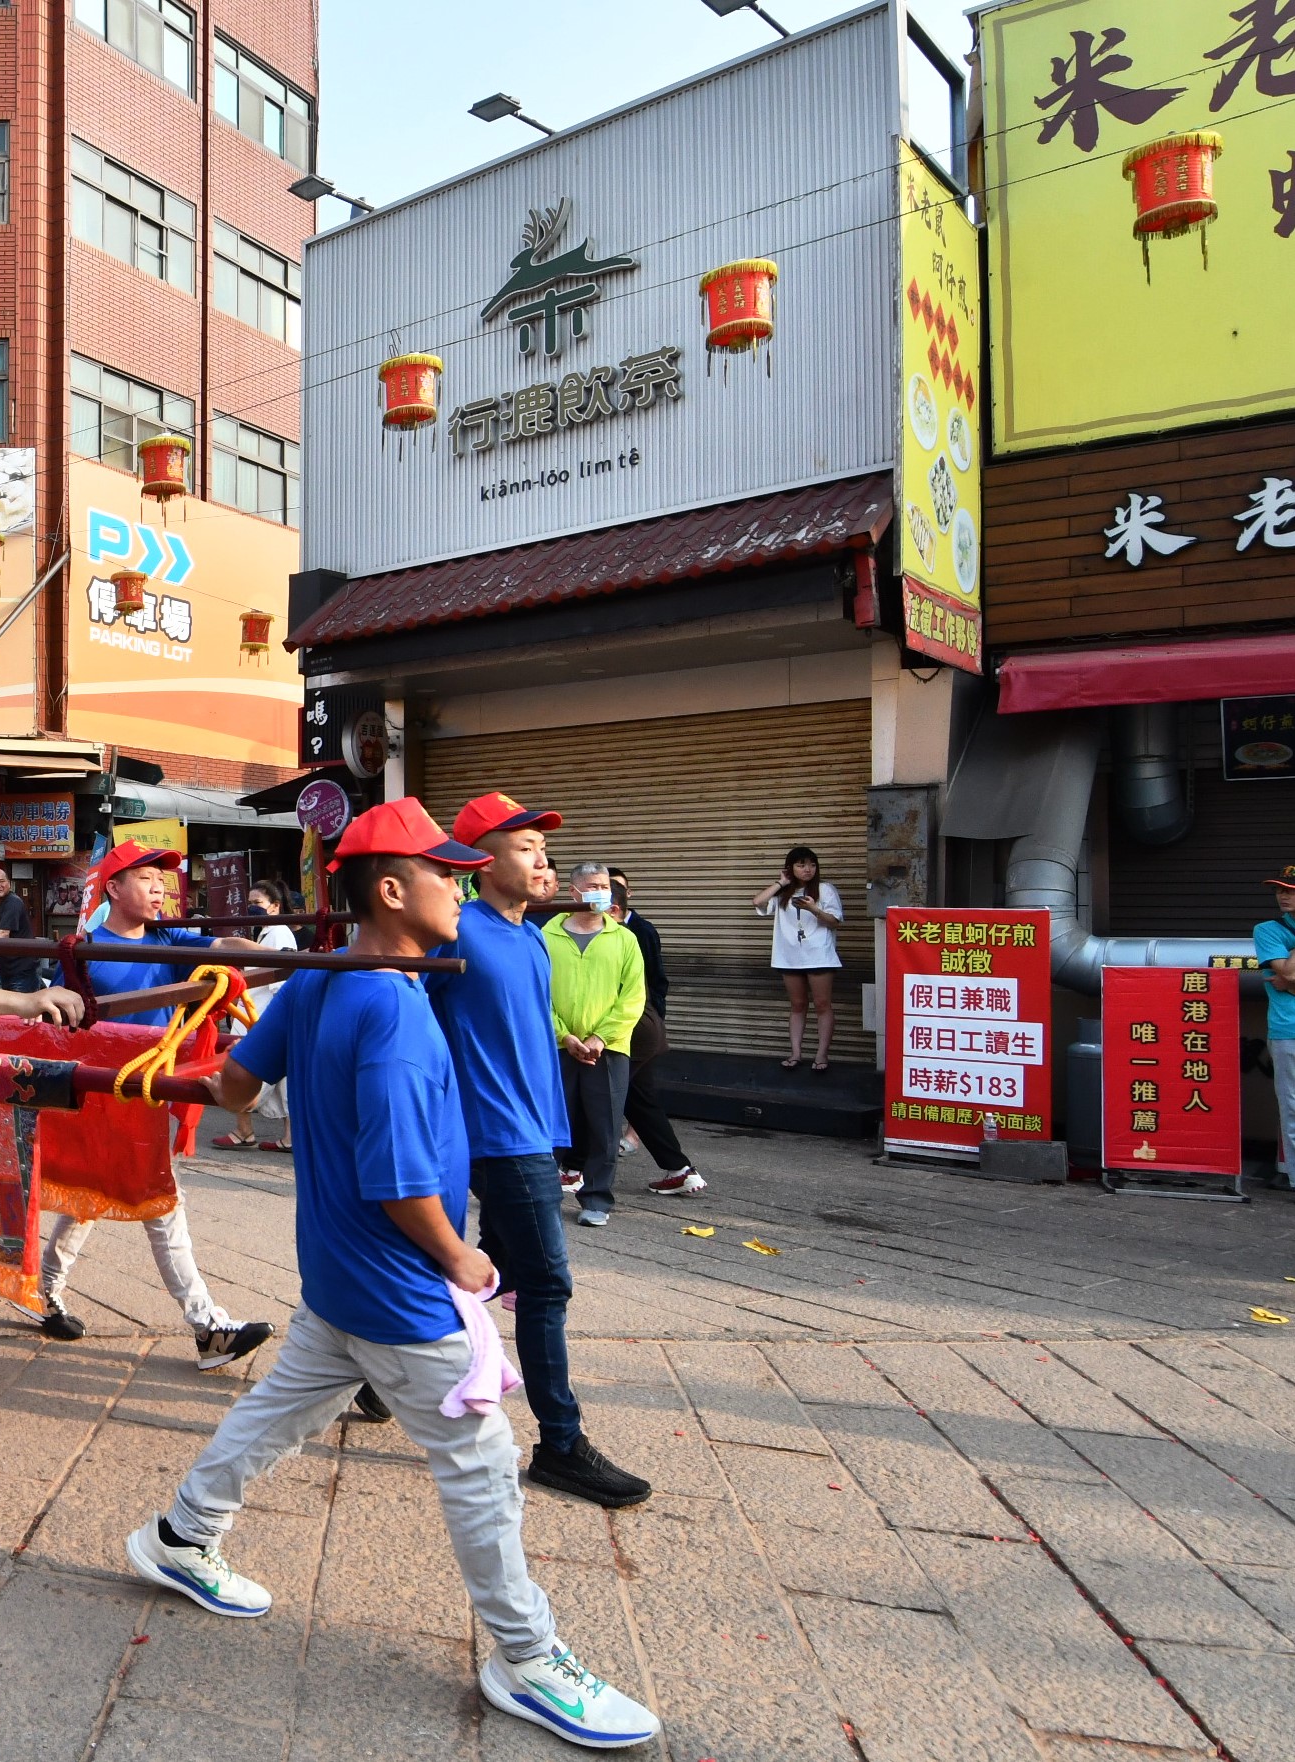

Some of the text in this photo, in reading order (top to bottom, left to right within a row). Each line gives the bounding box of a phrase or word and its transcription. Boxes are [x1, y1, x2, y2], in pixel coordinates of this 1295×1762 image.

[447, 345, 679, 456] 行漉飲茶
[89, 627, 193, 663] PARKING LOT
[898, 921, 1035, 947] 米老鼠蚵仔煎
[940, 948, 992, 974] 誠徵
[909, 984, 1011, 1012] 假日兼職
[909, 1026, 1036, 1057] 假日工讀生
[1182, 972, 1209, 1111] 鹿港在地人
[909, 1067, 1017, 1097] 時薪$183
[1132, 1023, 1157, 1132] 唯一推薦
[891, 1102, 1042, 1132] 請自備履歷入內面談
